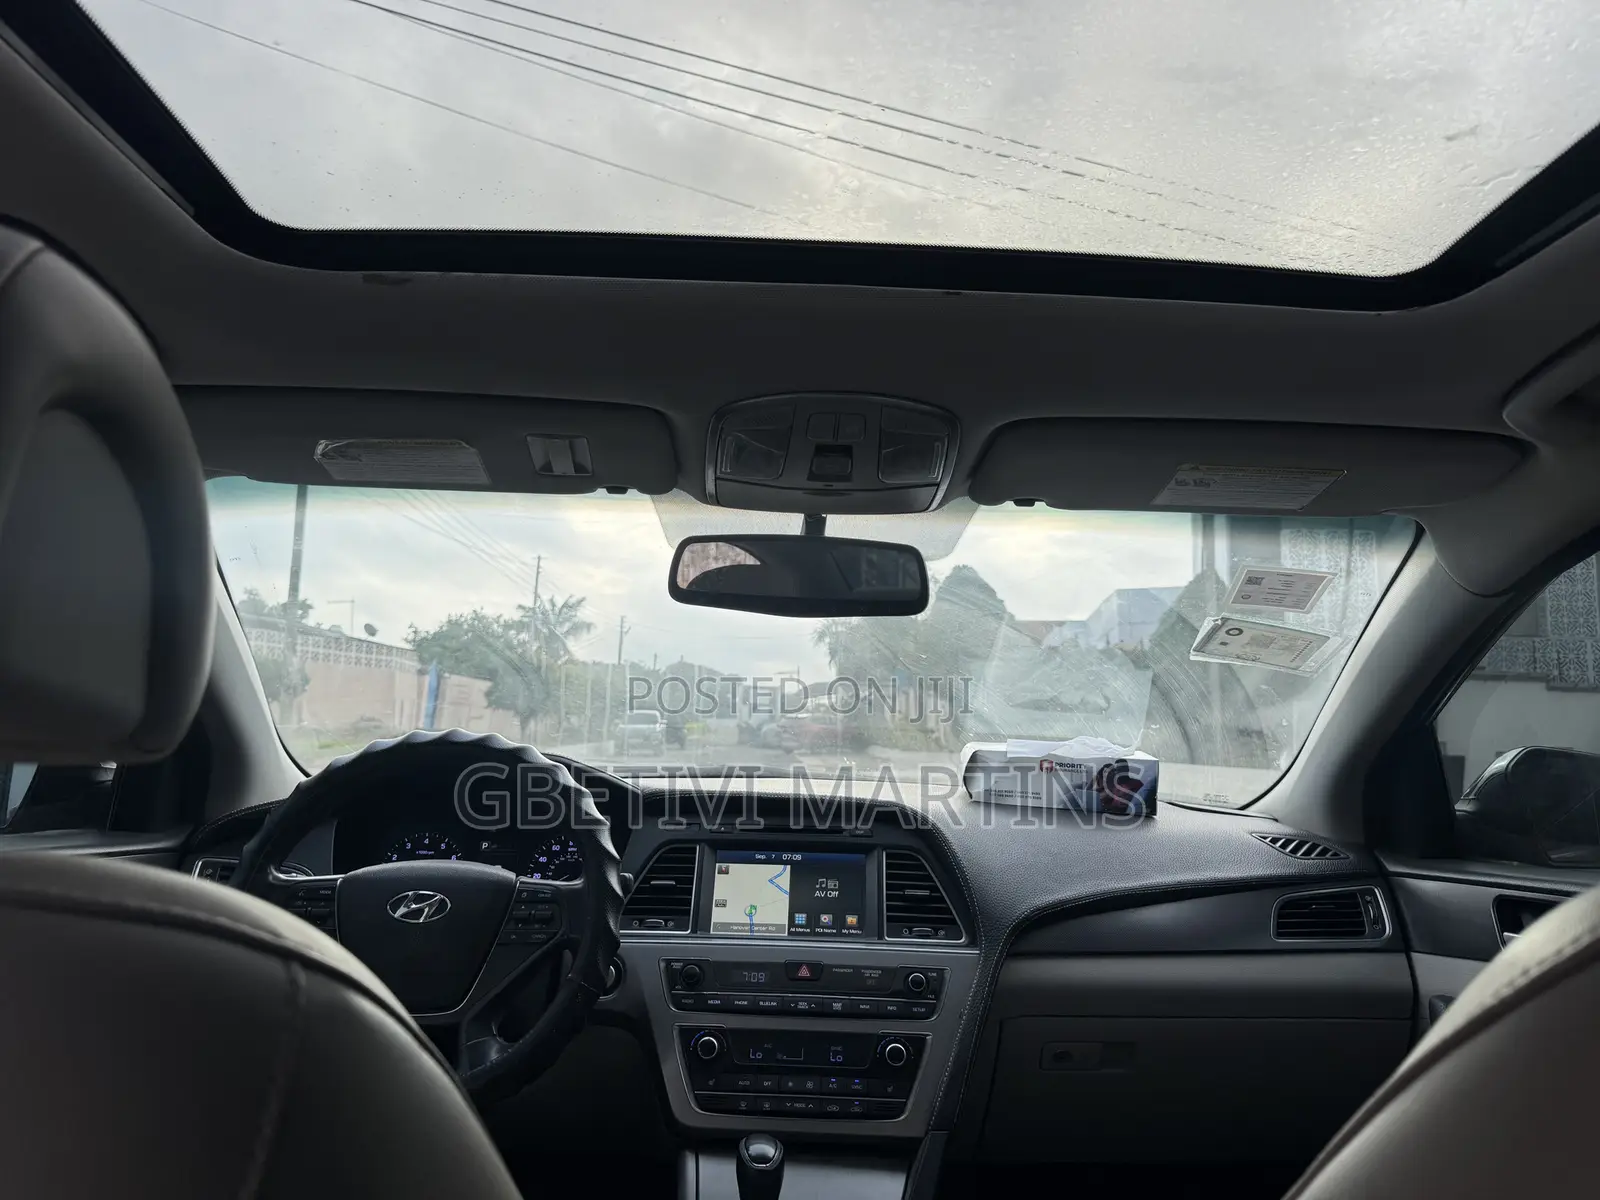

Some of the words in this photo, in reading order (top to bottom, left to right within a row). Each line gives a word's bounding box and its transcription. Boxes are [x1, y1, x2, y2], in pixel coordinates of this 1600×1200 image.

[406, 842, 411, 850] 3
[440, 842, 446, 850] 5
[755, 853, 767, 861] Sep.
[782, 853, 802, 861] 07:09
[814, 890, 826, 898] AV
[827, 890, 839, 898] Off
[842, 928, 850, 936] My
[742, 971, 766, 982] 7:09
[749, 1048, 763, 1059] Lo
